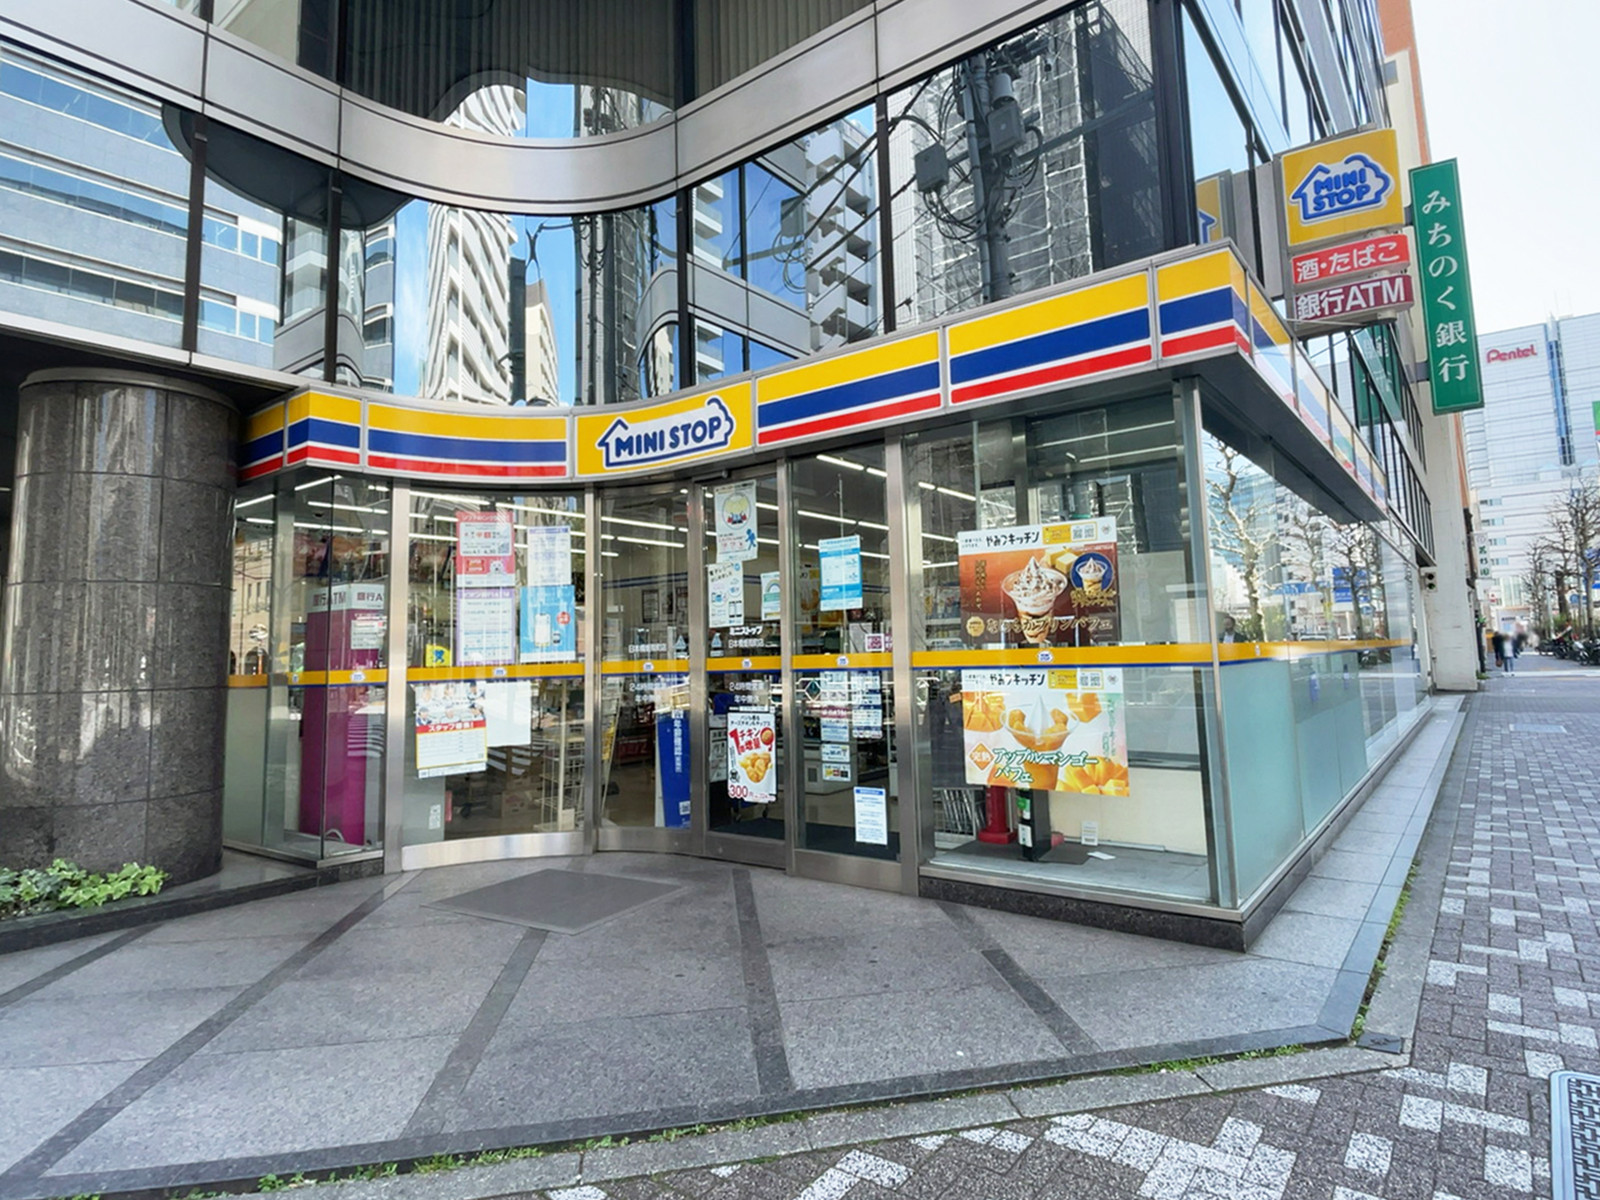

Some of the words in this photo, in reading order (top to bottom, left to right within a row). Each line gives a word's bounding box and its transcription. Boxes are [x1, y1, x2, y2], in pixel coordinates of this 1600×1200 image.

[1314, 168, 1367, 193] MINI
[1313, 184, 1371, 212] STOP
[1296, 241, 1400, 282] 酒・たばこ
[1297, 278, 1405, 320] 銀行ATM
[1422, 190, 1469, 383] みちのく銀行
[1486, 344, 1538, 363] Pentel
[615, 429, 665, 458] MINI
[669, 416, 722, 449] STOP
[985, 531, 1040, 548] やみつキッチン
[312, 591, 346, 607] 銀行TM
[992, 748, 1099, 767] アップルマンゴー
[995, 766, 1035, 783] パフェ
